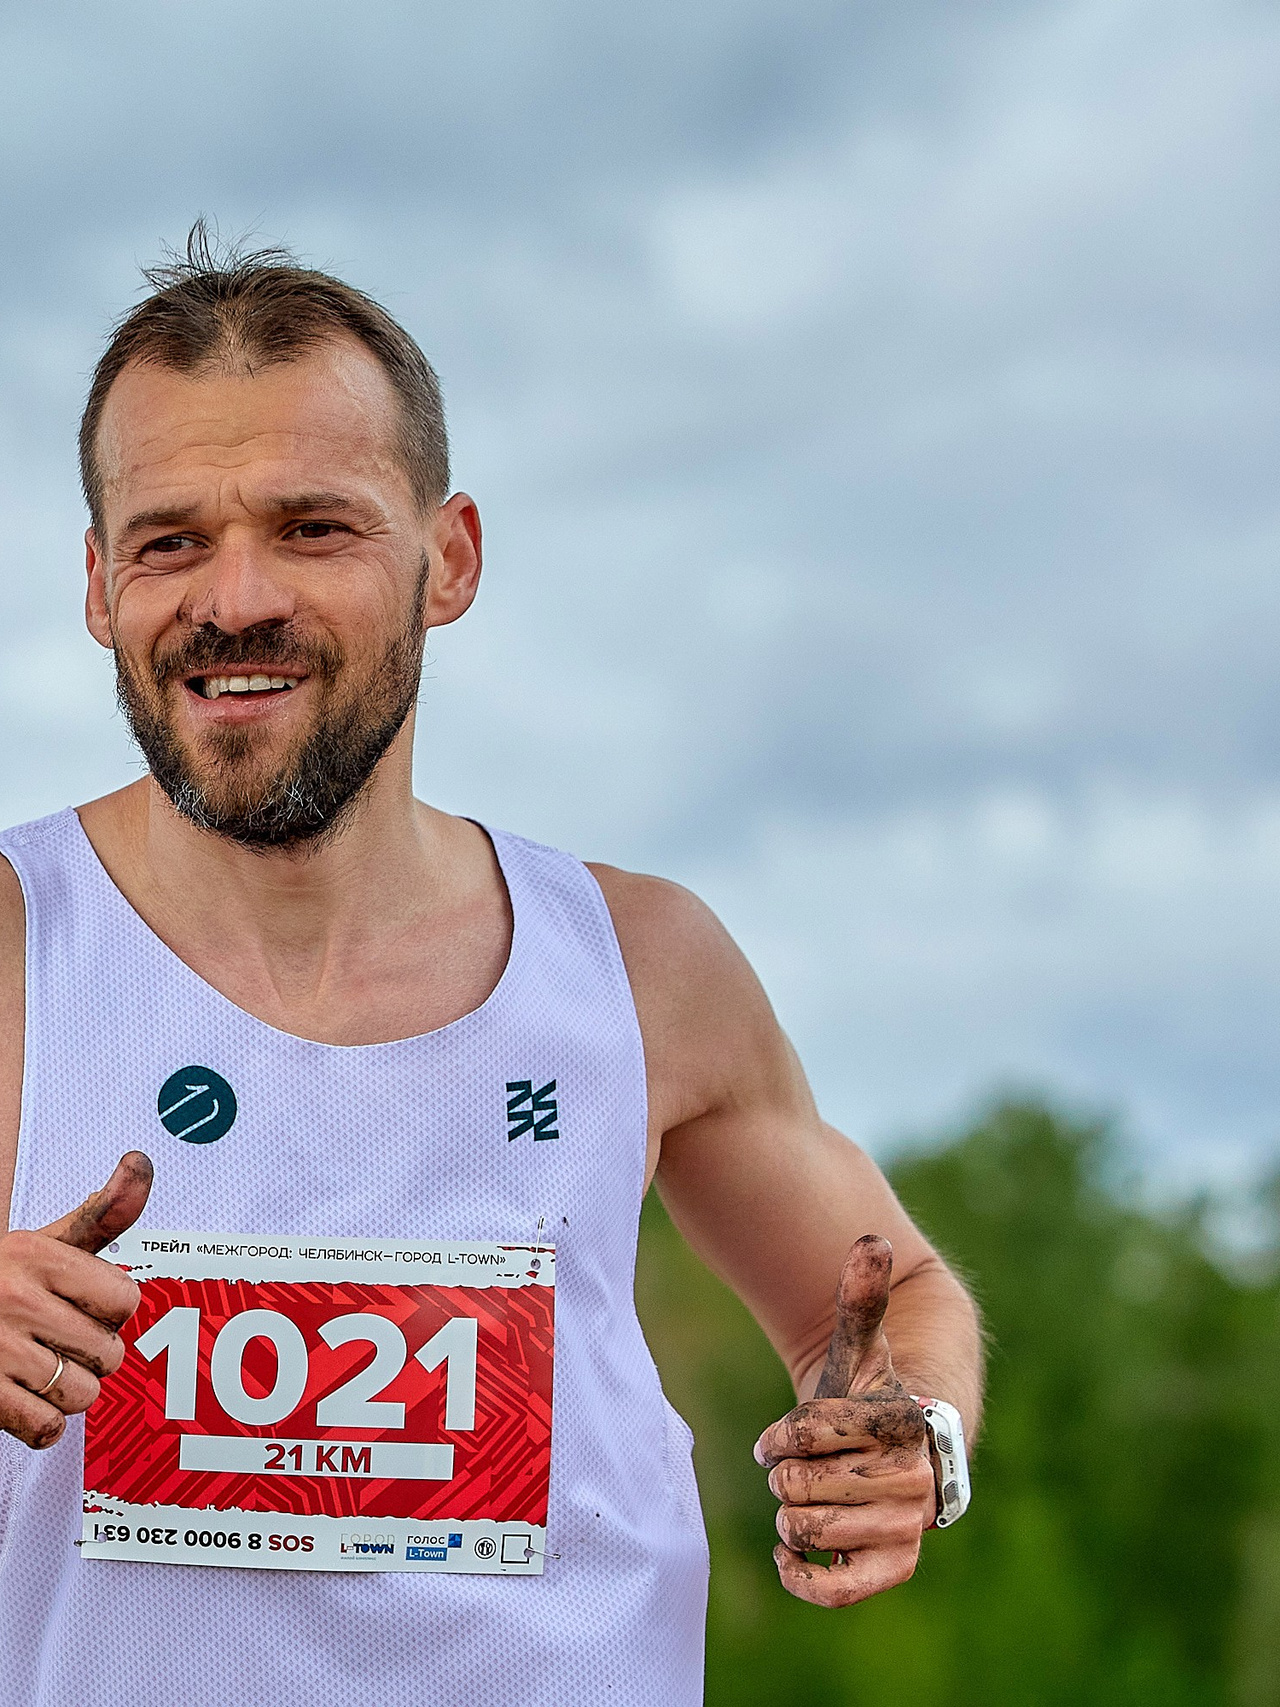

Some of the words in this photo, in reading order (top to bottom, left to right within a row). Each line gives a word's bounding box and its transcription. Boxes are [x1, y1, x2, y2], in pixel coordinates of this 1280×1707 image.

[141, 1240, 190, 1254] ТРЕЙЛ
[196, 1244, 293, 1259] «МЕЖГОРОД:
[448, 1253, 507, 1266] L-TOWN»
[133, 1306, 478, 1431] 1021
[264, 1443, 302, 1471] 21
[136, 1526, 178, 1546] 230
[184, 1529, 242, 1548] 9000
[247, 1532, 262, 1550] 8
[268, 1534, 315, 1552] SOS
[340, 1543, 395, 1554] L-TOWN
[409, 1549, 445, 1558] L-Town
